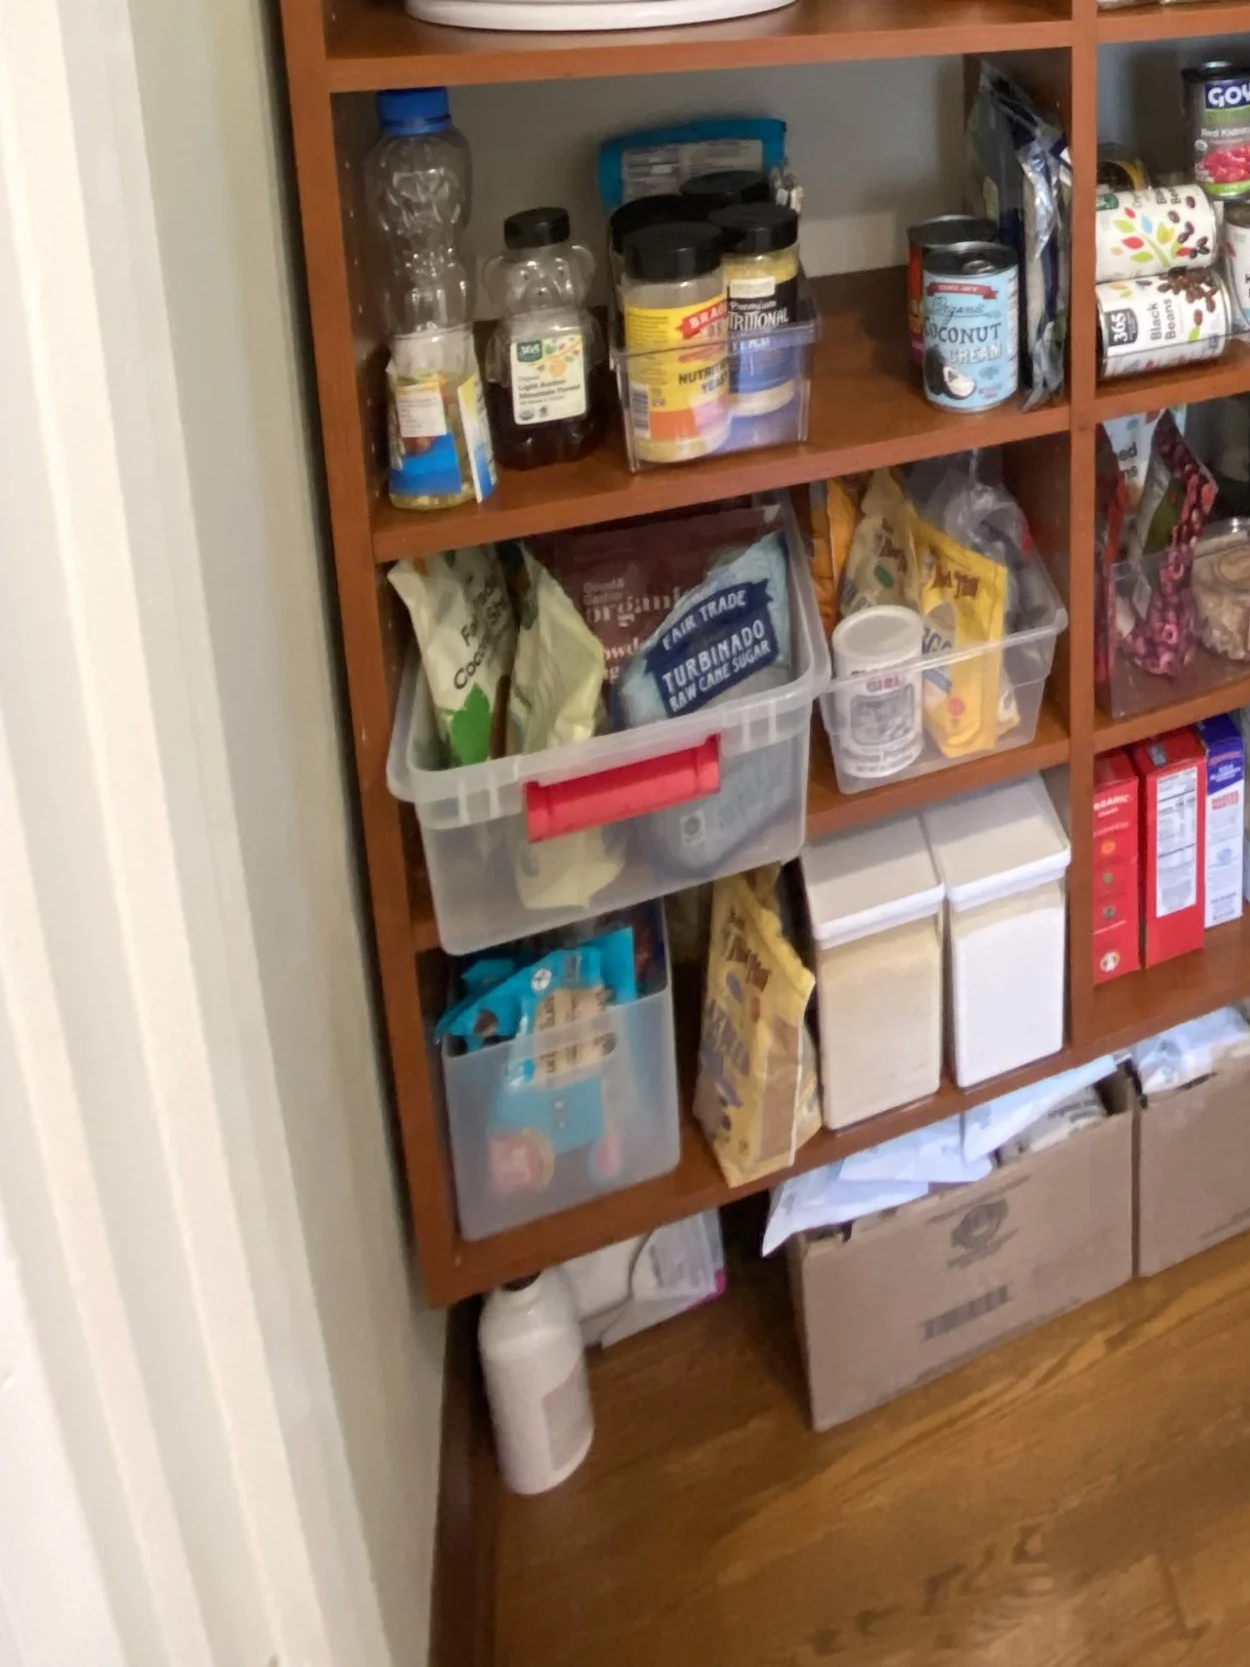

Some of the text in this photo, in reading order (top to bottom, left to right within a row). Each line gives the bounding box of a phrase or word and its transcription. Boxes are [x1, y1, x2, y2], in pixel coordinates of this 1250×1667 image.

[729, 307, 789, 331] TRITIONAL
[931, 295, 985, 324] Organic
[1146, 302, 1162, 341] Black
[1164, 298, 1178, 340] Beans
[924, 317, 1002, 345] COCONUT
[1111, 312, 1128, 343] 365
[519, 342, 541, 356] 365
[949, 342, 1003, 364] CREAM
[586, 586, 681, 628] organi
[662, 589, 747, 651] FAIR TRADE
[662, 619, 766, 695] TURBINADO
[668, 639, 772, 713] RAW CANE SUGAR
